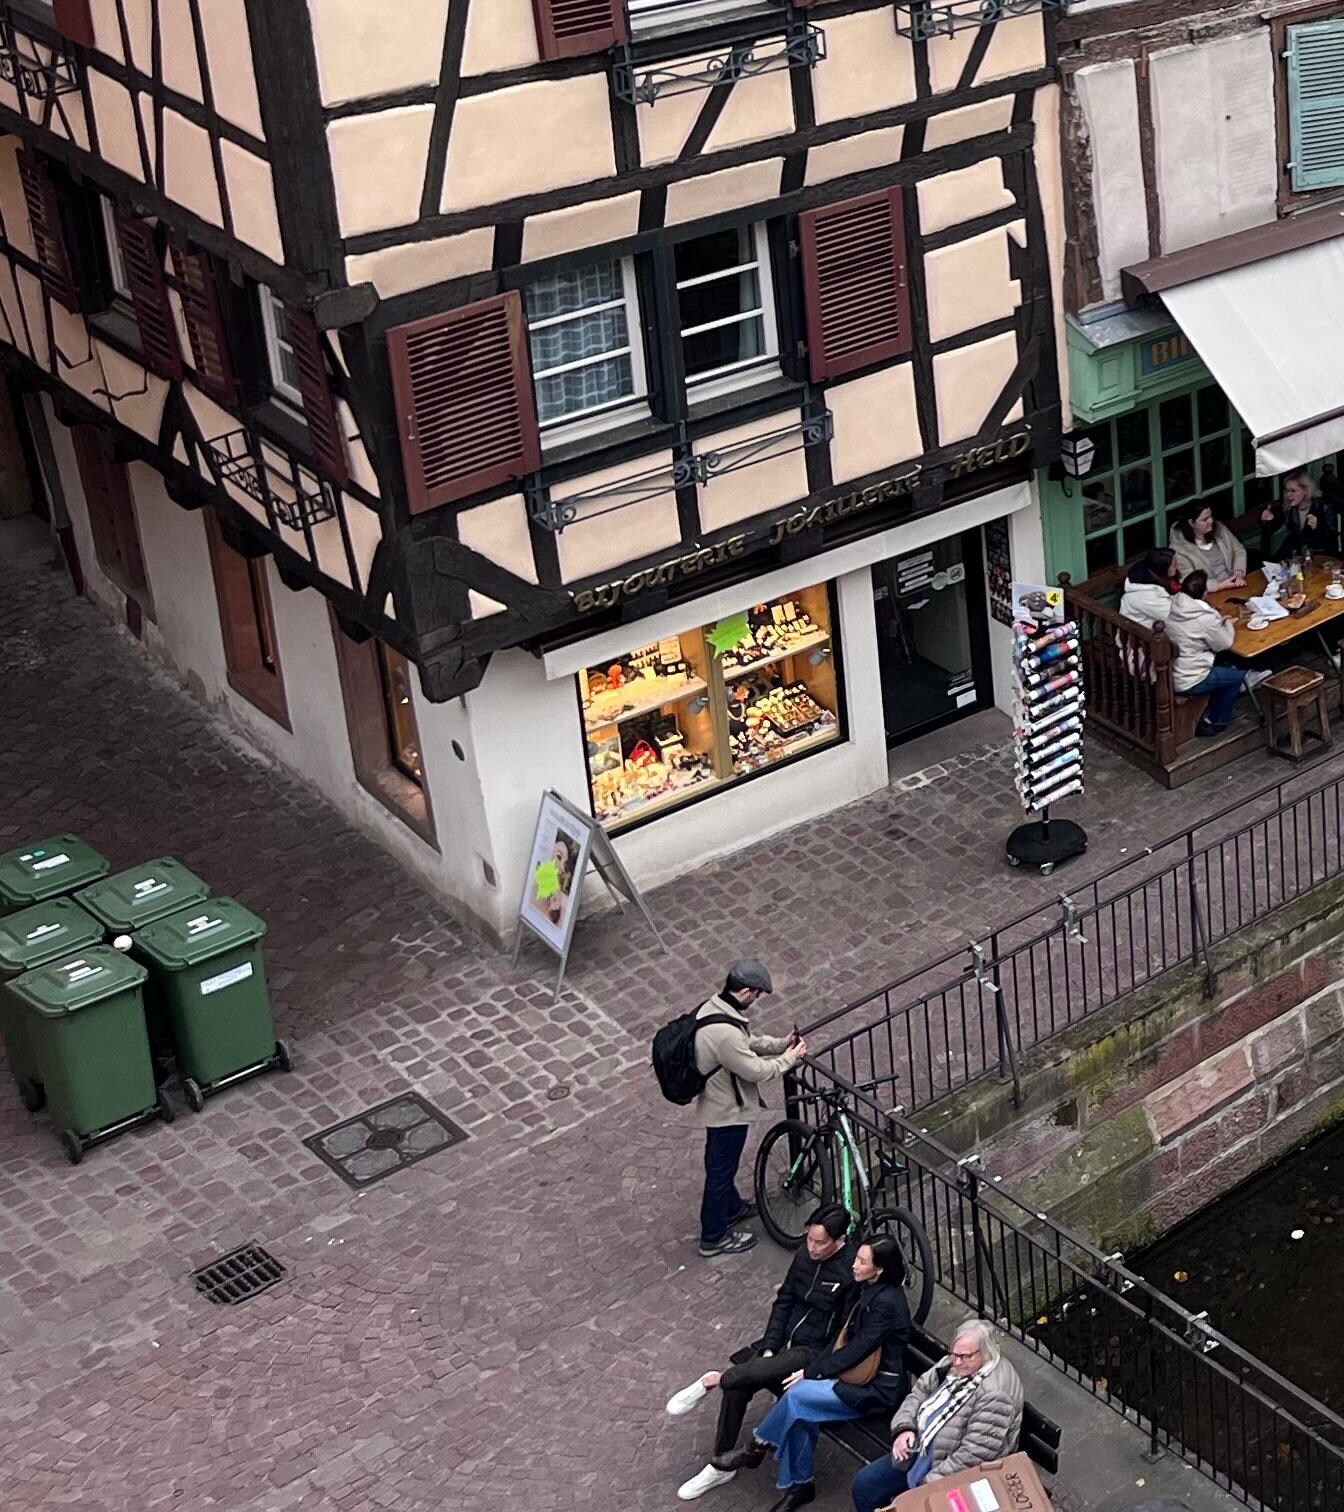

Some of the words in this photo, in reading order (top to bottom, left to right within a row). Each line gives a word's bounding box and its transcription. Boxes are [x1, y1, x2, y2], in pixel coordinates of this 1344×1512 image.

[575, 533, 746, 612] BIJOUTERIE
[768, 472, 920, 546] JOAILLERIE
[950, 432, 1032, 479] HELD
